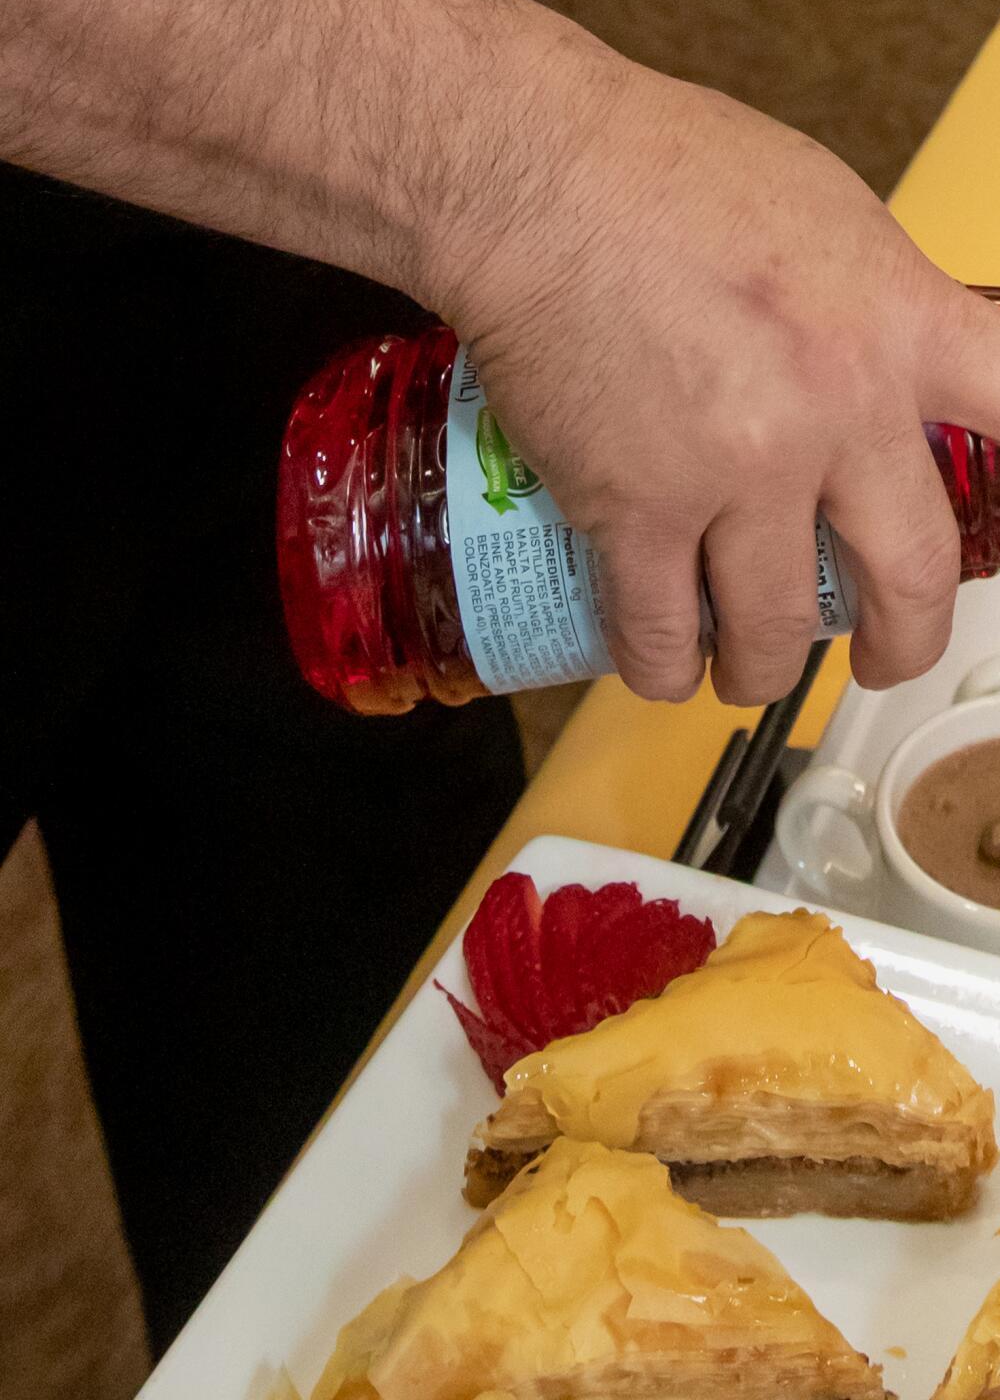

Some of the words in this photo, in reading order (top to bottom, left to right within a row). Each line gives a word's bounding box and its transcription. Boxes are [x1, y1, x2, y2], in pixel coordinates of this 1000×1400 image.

[463, 536, 478, 582] COLOR
[477, 534, 495, 601] BENZOATE
[489, 532, 502, 564] PINE
[502, 530, 517, 575] GRAPE
[515, 527, 530, 574] MALTA
[529, 526, 549, 600] DISTILLATES
[543, 524, 565, 613] INGREDIENTS:
[561, 527, 578, 577] Protein
[570, 586, 581, 602] 0g
[467, 584, 484, 614] (RED
[494, 566, 507, 594] AND
